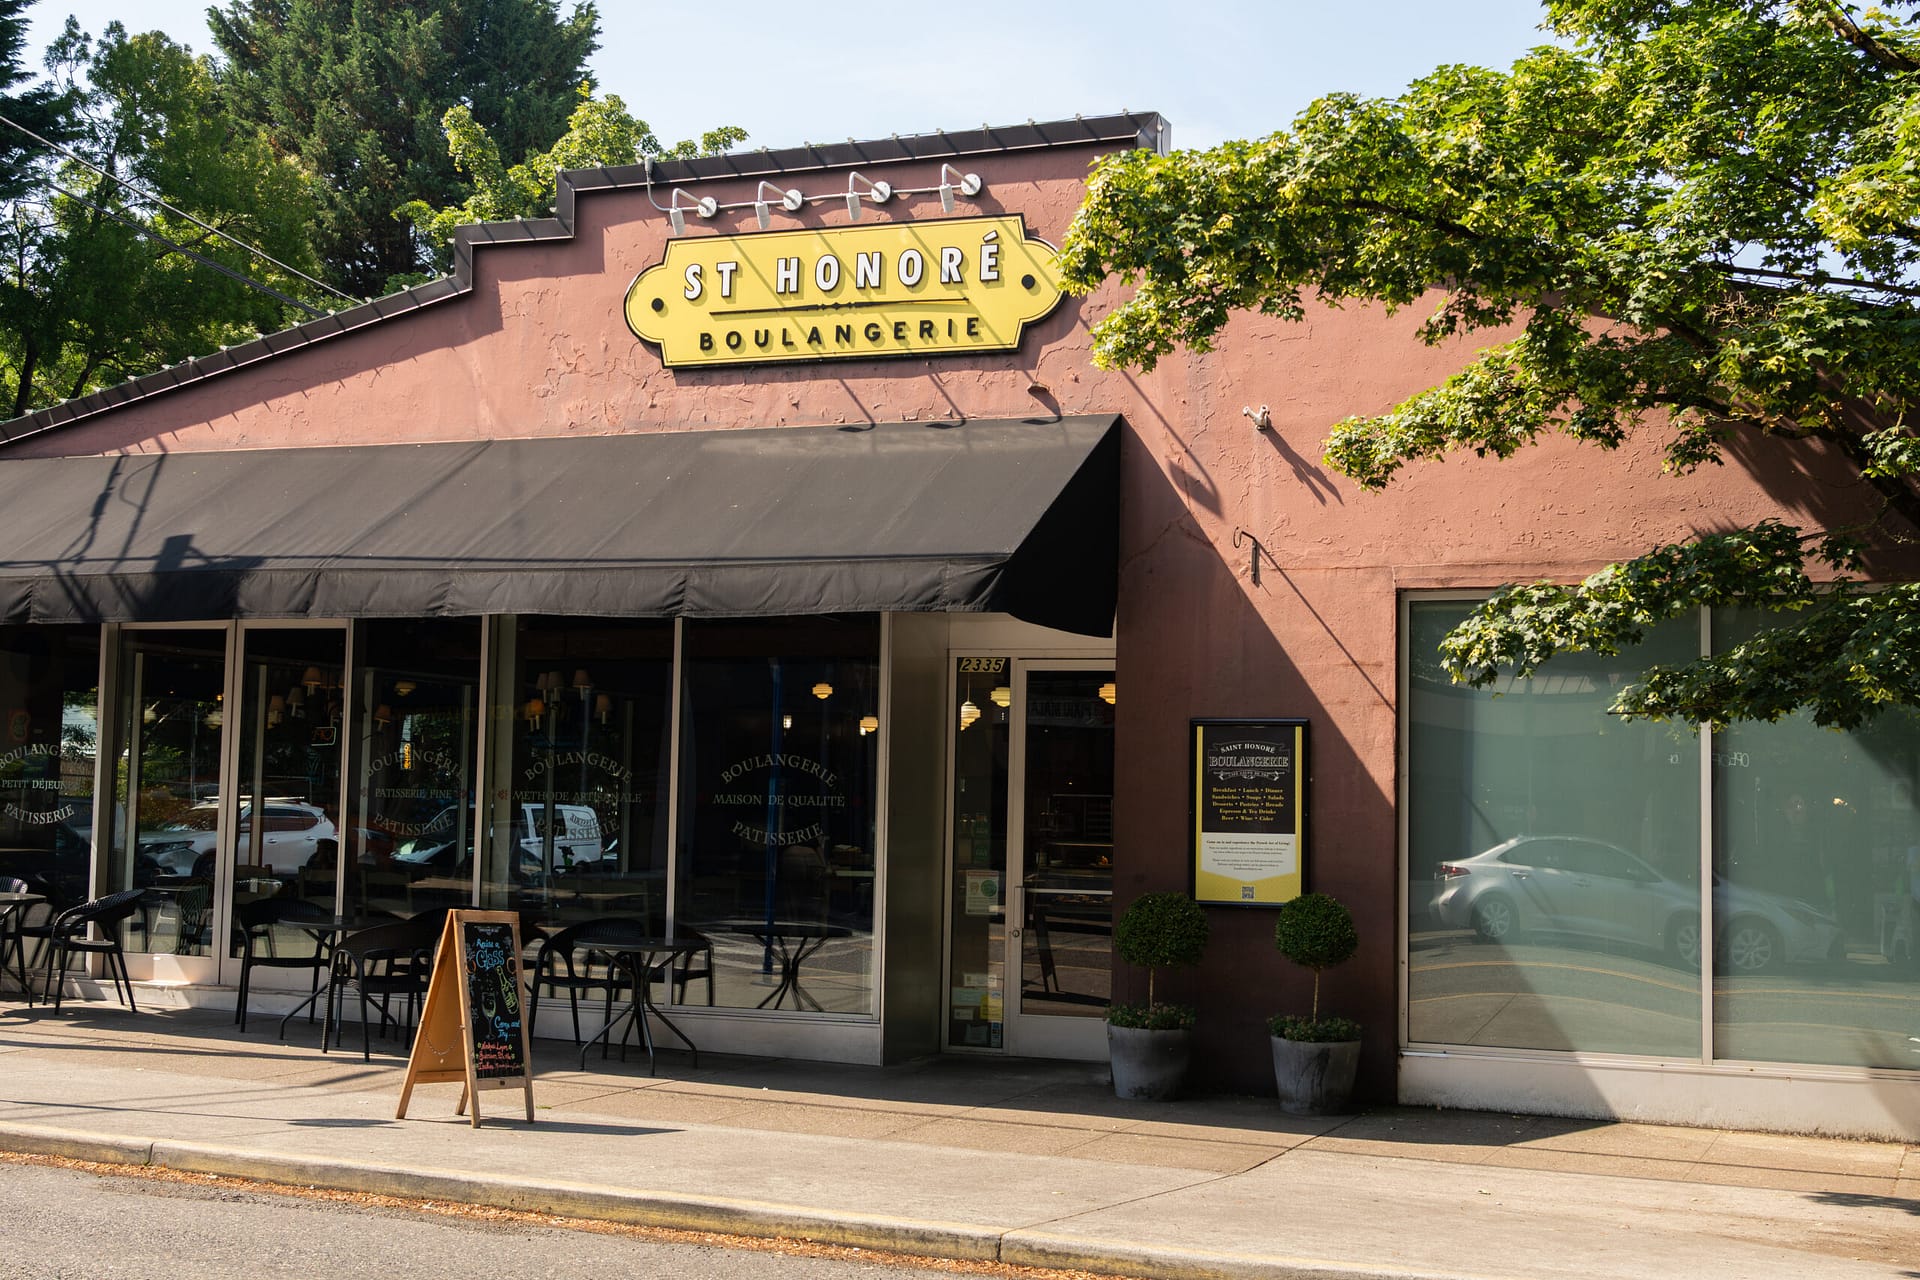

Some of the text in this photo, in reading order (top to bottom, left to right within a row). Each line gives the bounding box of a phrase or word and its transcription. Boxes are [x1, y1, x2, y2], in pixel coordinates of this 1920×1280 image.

[684, 230, 999, 301] ST HONORÉ
[699, 317, 980, 351] BOULANGERIE
[961, 658, 1003, 672] 2335
[1220, 743, 1242, 754] SAINT
[524, 752, 632, 784] BOULANGERIE
[721, 753, 837, 787] BOULANGERIE
[1209, 756, 1289, 767] BOULANGERIE
[2, 780, 28, 790] PETIT
[375, 788, 425, 799] PATISSERIE
[712, 793, 846, 808] MAISON DE QUALITÉ
[4, 802, 75, 825] PATISSERIE
[373, 813, 454, 836] PATISSERIE
[732, 821, 824, 847] PATISSERIE
